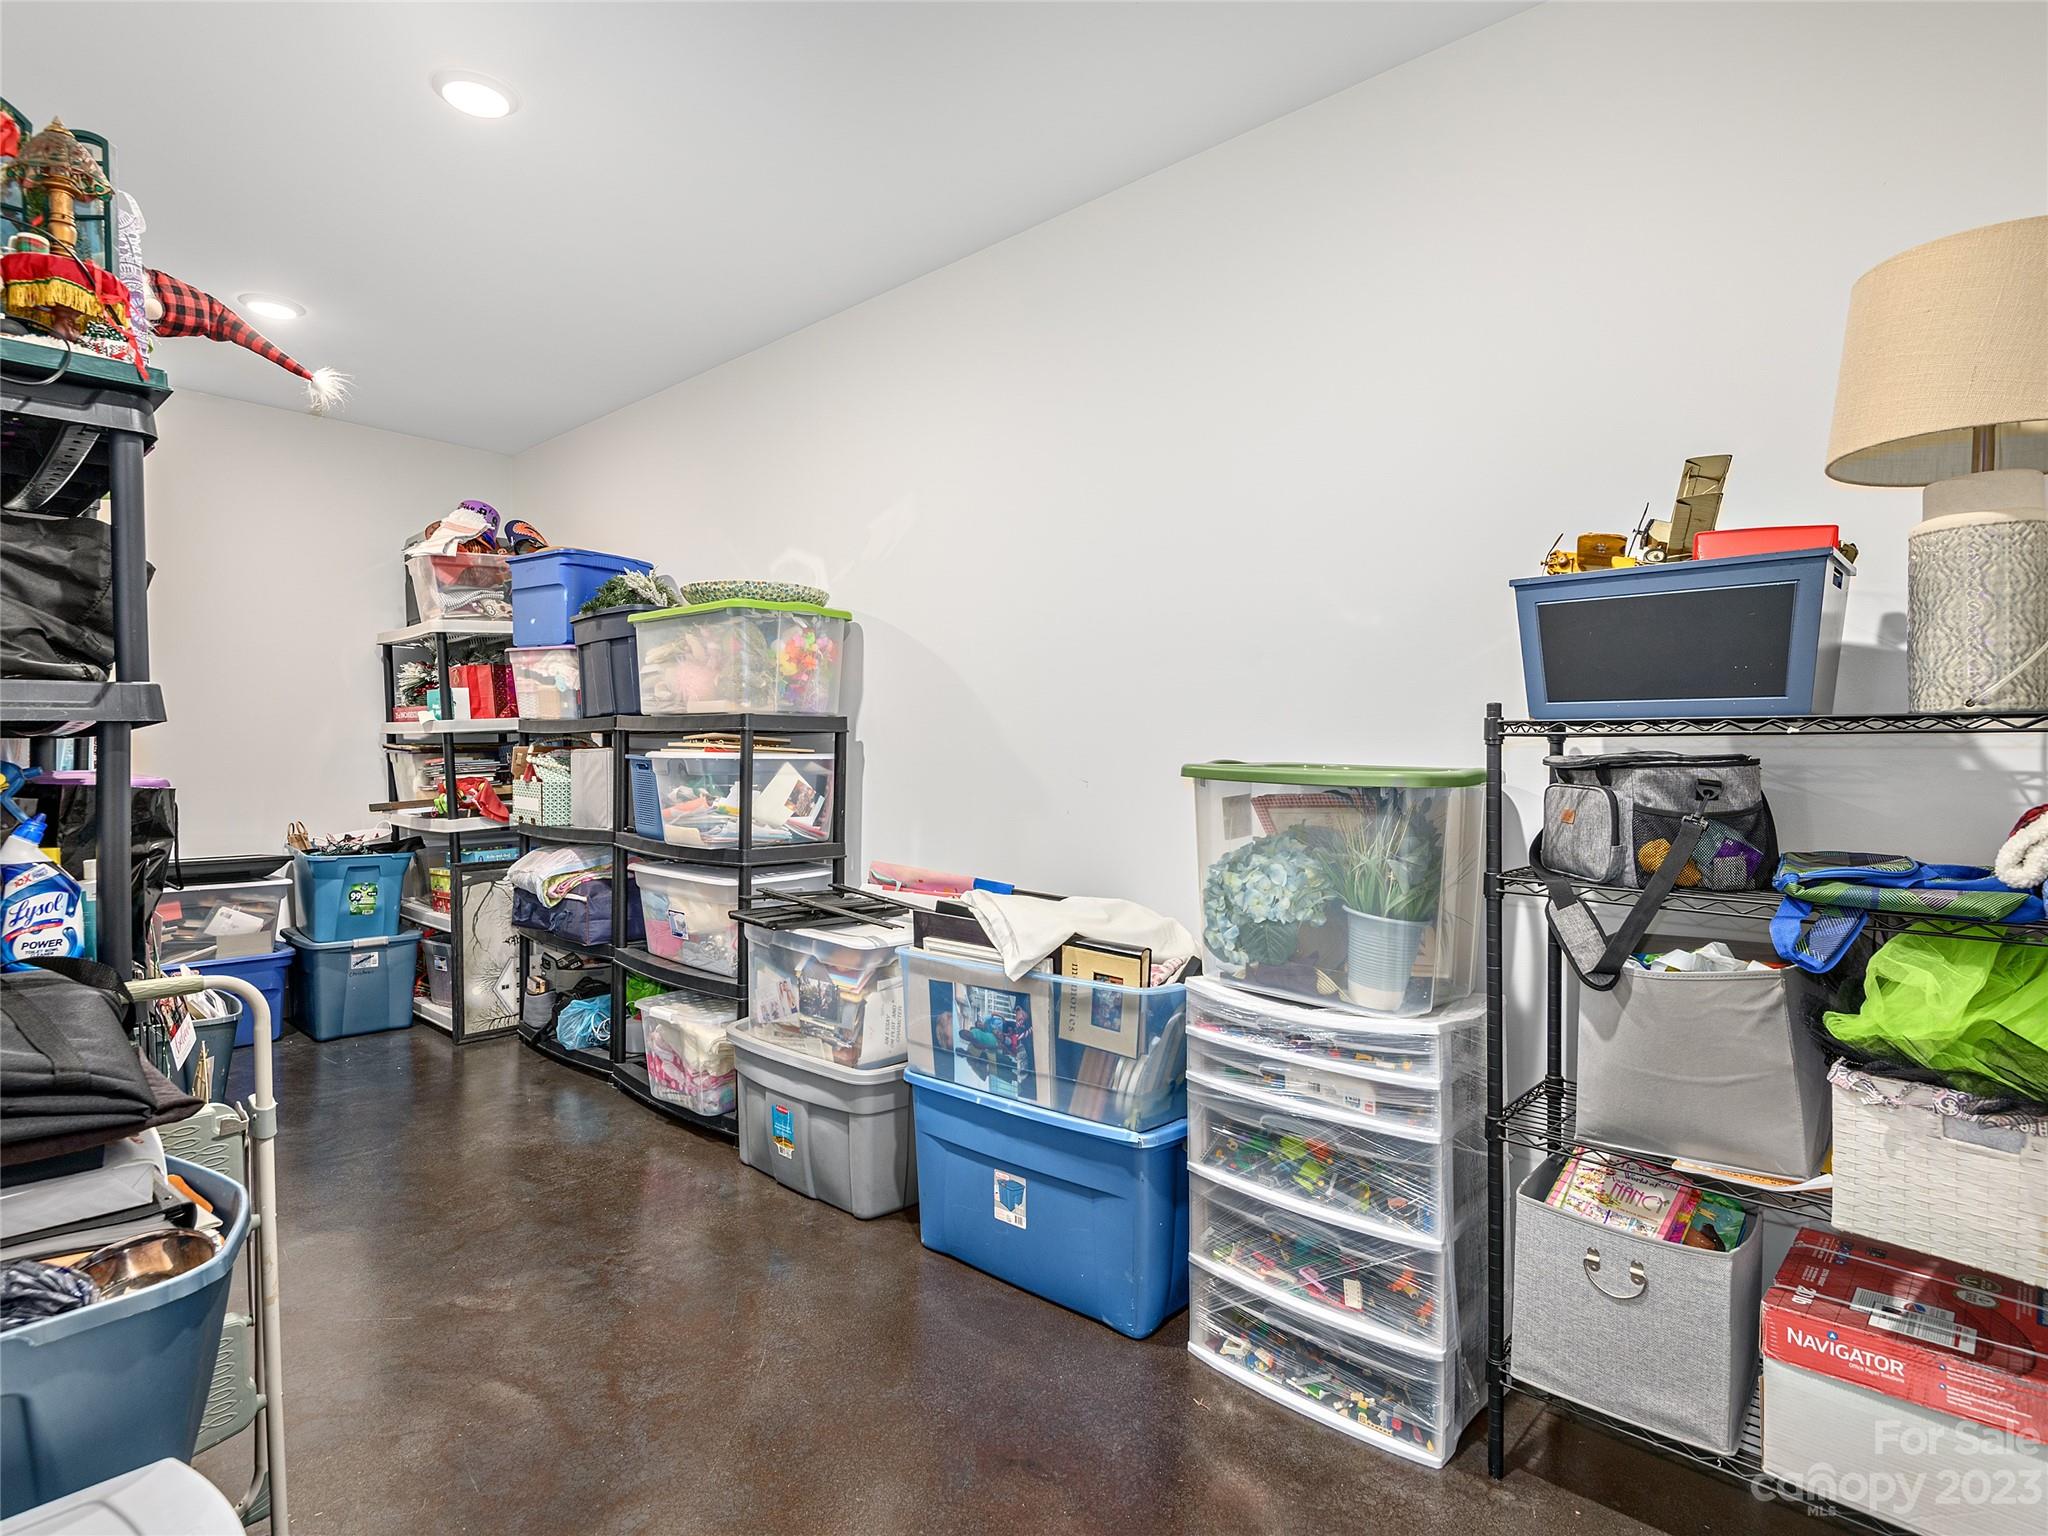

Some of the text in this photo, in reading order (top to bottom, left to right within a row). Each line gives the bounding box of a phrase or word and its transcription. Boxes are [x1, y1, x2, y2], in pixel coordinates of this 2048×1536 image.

[8, 893, 63, 927] Lysol
[20, 938, 63, 951] POWER
[1068, 963, 1079, 1032] mmories
[1609, 1182, 1671, 1214] NANCY
[1786, 1326, 1905, 1377] NAVIGATOR
